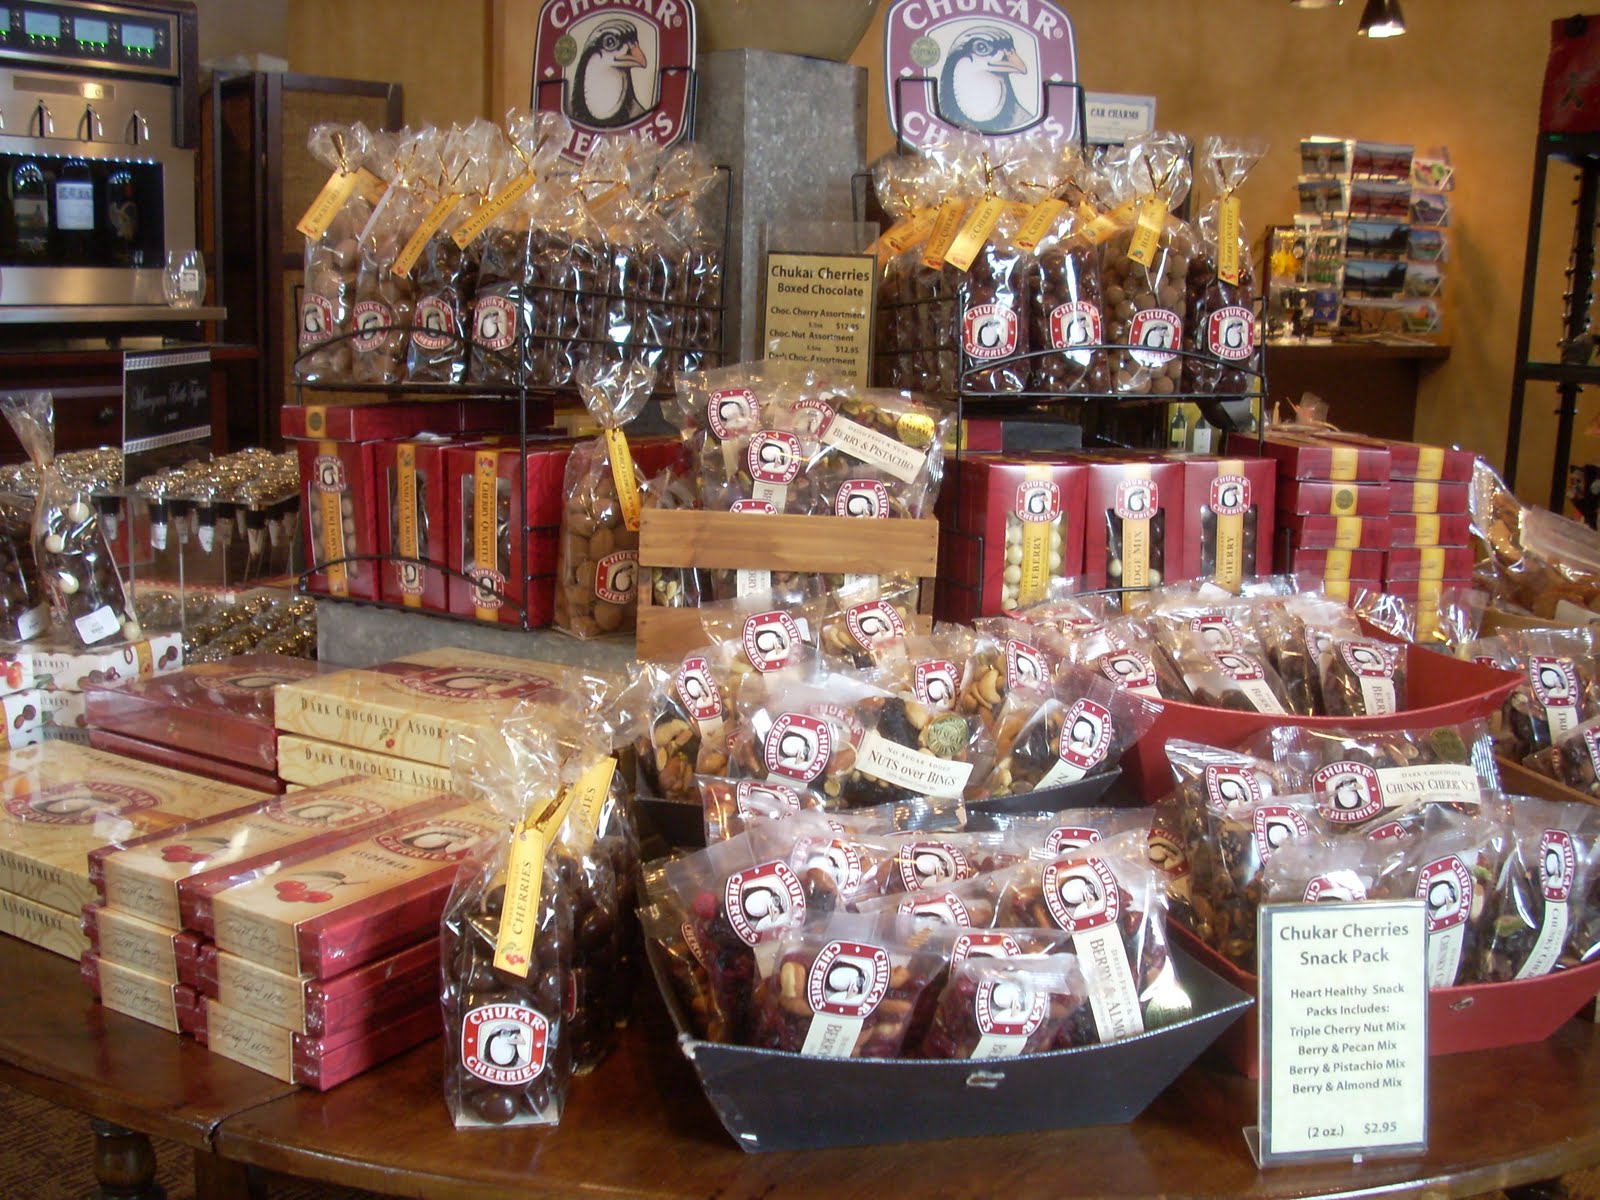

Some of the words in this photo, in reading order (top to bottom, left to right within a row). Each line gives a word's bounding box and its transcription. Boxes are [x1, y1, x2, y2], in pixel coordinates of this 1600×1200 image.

[818, 267, 870, 281] Cherries
[778, 283, 808, 294] Boxed
[811, 284, 864, 297] Chocolate
[770, 306, 792, 315] Choc.
[793, 307, 818, 318] Cherry
[1137, 311, 1180, 328] CHUKAR
[1213, 307, 1253, 322] CHUKAR
[769, 329, 791, 339] Choc.
[792, 330, 806, 339] Nut
[809, 331, 854, 342] Assortment
[835, 346, 859, 354] $12.95
[965, 342, 1013, 357] CHERRIES
[1211, 342, 1252, 358] CHERRIES
[788, 353, 809, 362] Choc.
[810, 355, 855, 366] Assortment
[710, 393, 727, 437] CHERRIES
[750, 433, 767, 478] CHERRIES
[782, 437, 802, 482] CHUKAR
[833, 428, 858, 446] BERRY
[861, 442, 869, 451] &
[870, 444, 914, 470] PISTACHIO
[1021, 481, 1057, 494] CHUKAR
[1120, 480, 1156, 491] CHUKAR
[1214, 476, 1249, 487] CHUKAR
[482, 481, 490, 519] CHERRY
[1119, 508, 1156, 519] CHERRIES
[1213, 503, 1248, 515] CHERRIES
[1019, 510, 1056, 522] CHERRIES
[481, 521, 490, 564] QUARTET
[1133, 531, 1143, 553] MIX
[1226, 537, 1235, 584] CHERRY
[746, 619, 767, 670] CHERRIES
[850, 609, 875, 651] CHERRIES
[1008, 642, 1018, 689] CHERRIES
[675, 664, 700, 717] CHERRIES
[301, 697, 330, 715] DARK
[336, 700, 400, 731] CHOCOLATE
[1061, 701, 1085, 756] CHERRIES
[767, 715, 792, 771] CHERRIES
[803, 724, 829, 780] CHUKAR
[1086, 713, 1110, 767] CHUKAR
[305, 746, 334, 766] DARK
[340, 755, 403, 783] CHOCOLATE
[412, 770, 454, 792] ASSORT
[869, 750, 898, 771] NUTS
[900, 766, 925, 780] over
[928, 770, 956, 787] BINGS
[1316, 763, 1373, 783] CHUKAR
[1239, 769, 1261, 801] CHUK
[1386, 782, 1425, 795] CHUNKY
[1322, 800, 1380, 820] CHERRIES
[1257, 809, 1273, 863] CHERRIE
[1562, 837, 1574, 898] CHUKAR
[512, 859, 533, 936] CHERRIES
[1045, 865, 1077, 932] CHERRIES
[1086, 857, 1118, 920] CHUKAR
[1451, 859, 1469, 920] CHUKAR
[727, 874, 759, 944] CHERRIES
[945, 893, 968, 928] CHU
[1280, 925, 1339, 941] Chukar
[1342, 923, 1409, 938] Cherries
[1300, 949, 1348, 965] Snack
[1353, 948, 1390, 963] Pack
[811, 943, 842, 1011] CHERRIES
[860, 950, 889, 1016] CHUKAR
[1090, 938, 1113, 979] BERRY
[1107, 1002, 1128, 1037] ALMO
[1290, 987, 1323, 999] Heart
[1325, 985, 1367, 998] Healthy
[1372, 983, 1405, 995] Snack
[1306, 1005, 1337, 1017] Packs
[1340, 1003, 1390, 1015] Includes:
[1289, 1025, 1321, 1038] Triple
[1323, 1024, 1361, 1037] Cherry
[1363, 1023, 1383, 1033] Nut
[1386, 1021, 1406, 1032] Mix
[1298, 1045, 1329, 1057] Berry
[1331, 1043, 1340, 1054] &
[1342, 1041, 1374, 1053] Pecan
[1377, 1040, 1397, 1051] Mix
[466, 1054, 541, 1082] CHERRIES
[1289, 1064, 1320, 1076] Berry
[1322, 1063, 1331, 1073] &
[1333, 1060, 1384, 1073] Pistachio
[1386, 1059, 1406, 1069] Mix
[1292, 1082, 1323, 1095] Berry
[1326, 1082, 1334, 1092] &
[1336, 1079, 1380, 1091] Almond
[1382, 1077, 1402, 1088] Mix
[1307, 1126, 1320, 1139] (2
[1322, 1125, 1344, 1138] oz.)
[1364, 1122, 1398, 1135] $2.95
